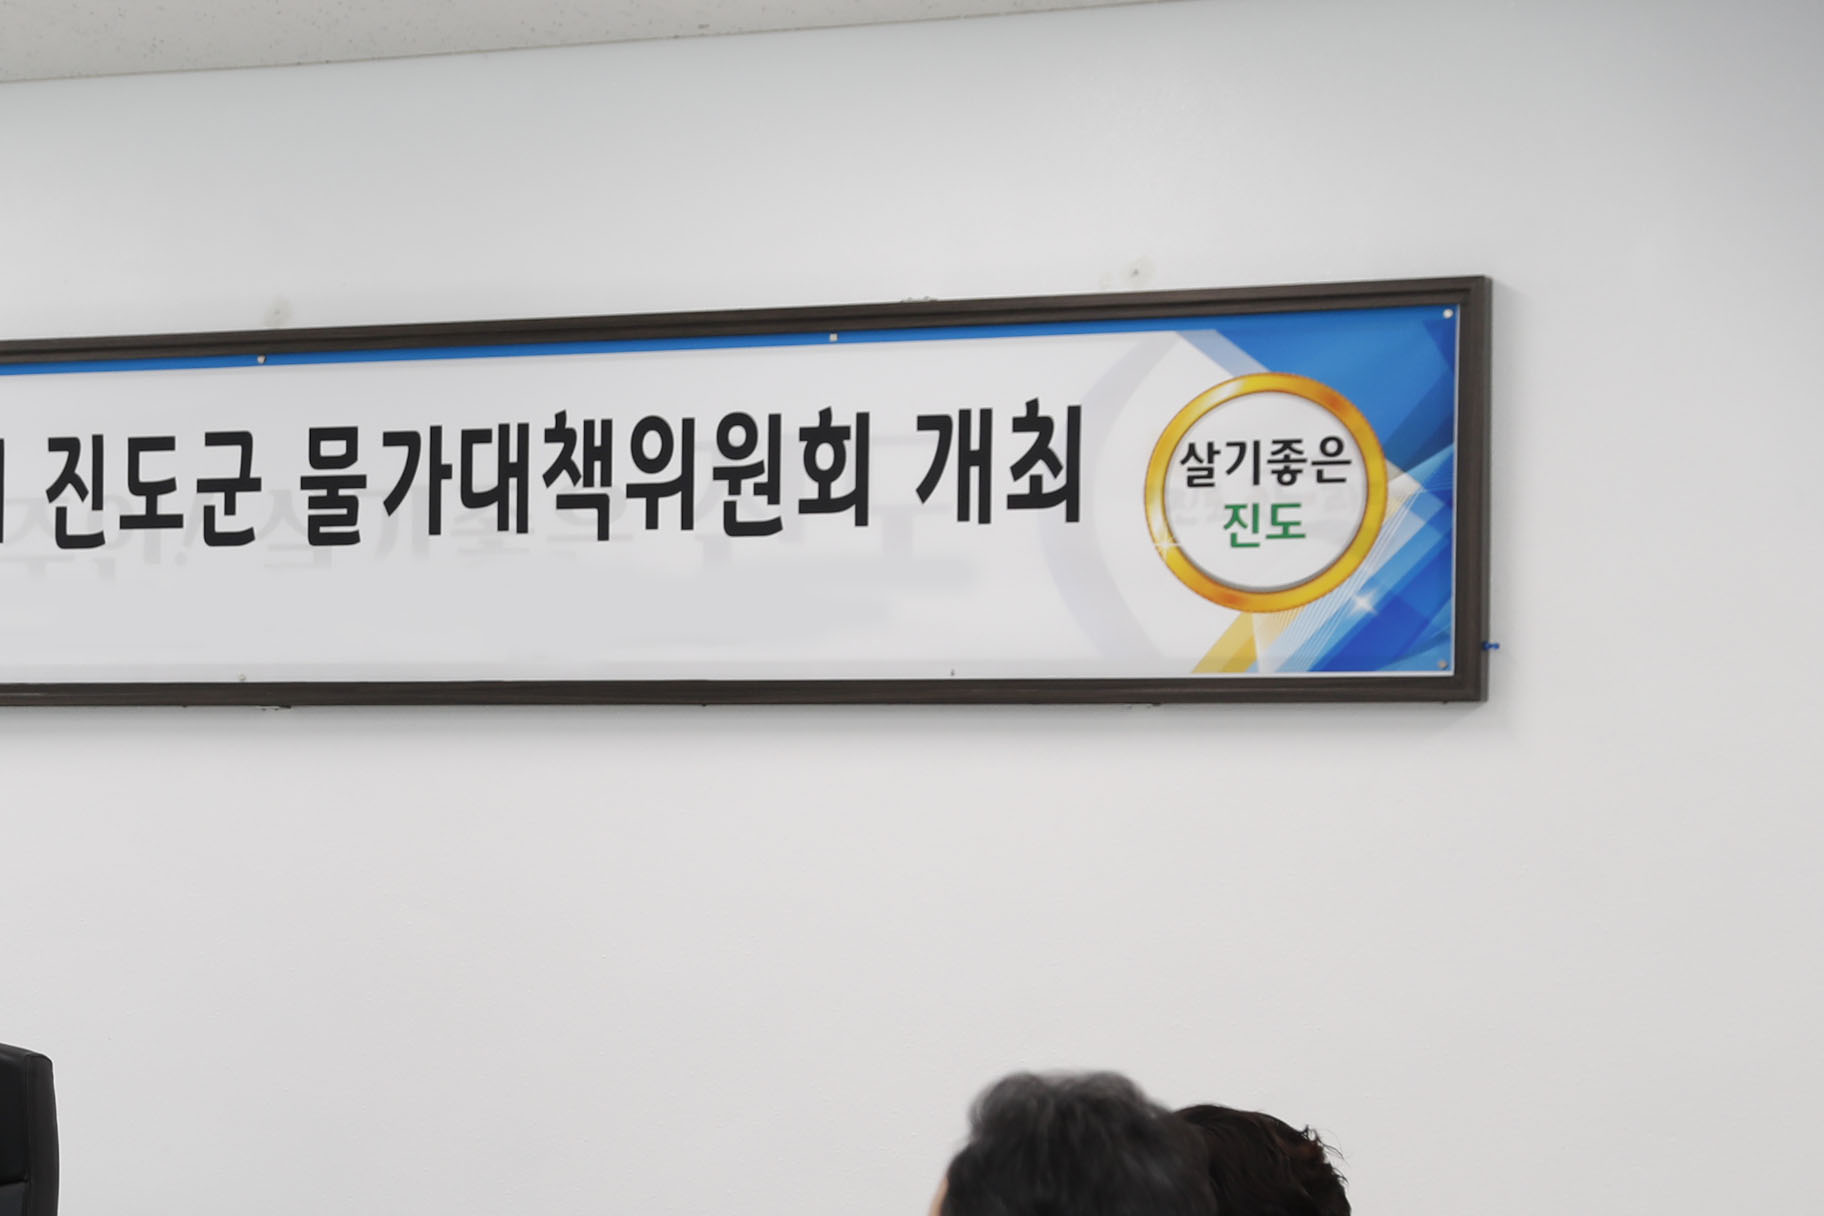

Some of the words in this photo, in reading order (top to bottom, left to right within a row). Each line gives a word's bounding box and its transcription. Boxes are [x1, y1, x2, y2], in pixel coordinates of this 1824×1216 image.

[45, 430, 262, 550] 진도군
[300, 406, 871, 547] 물가대책위원회
[915, 396, 1082, 525] 개최
[1178, 434, 1354, 488] 살기좋은
[1222, 502, 1307, 549] 진도
